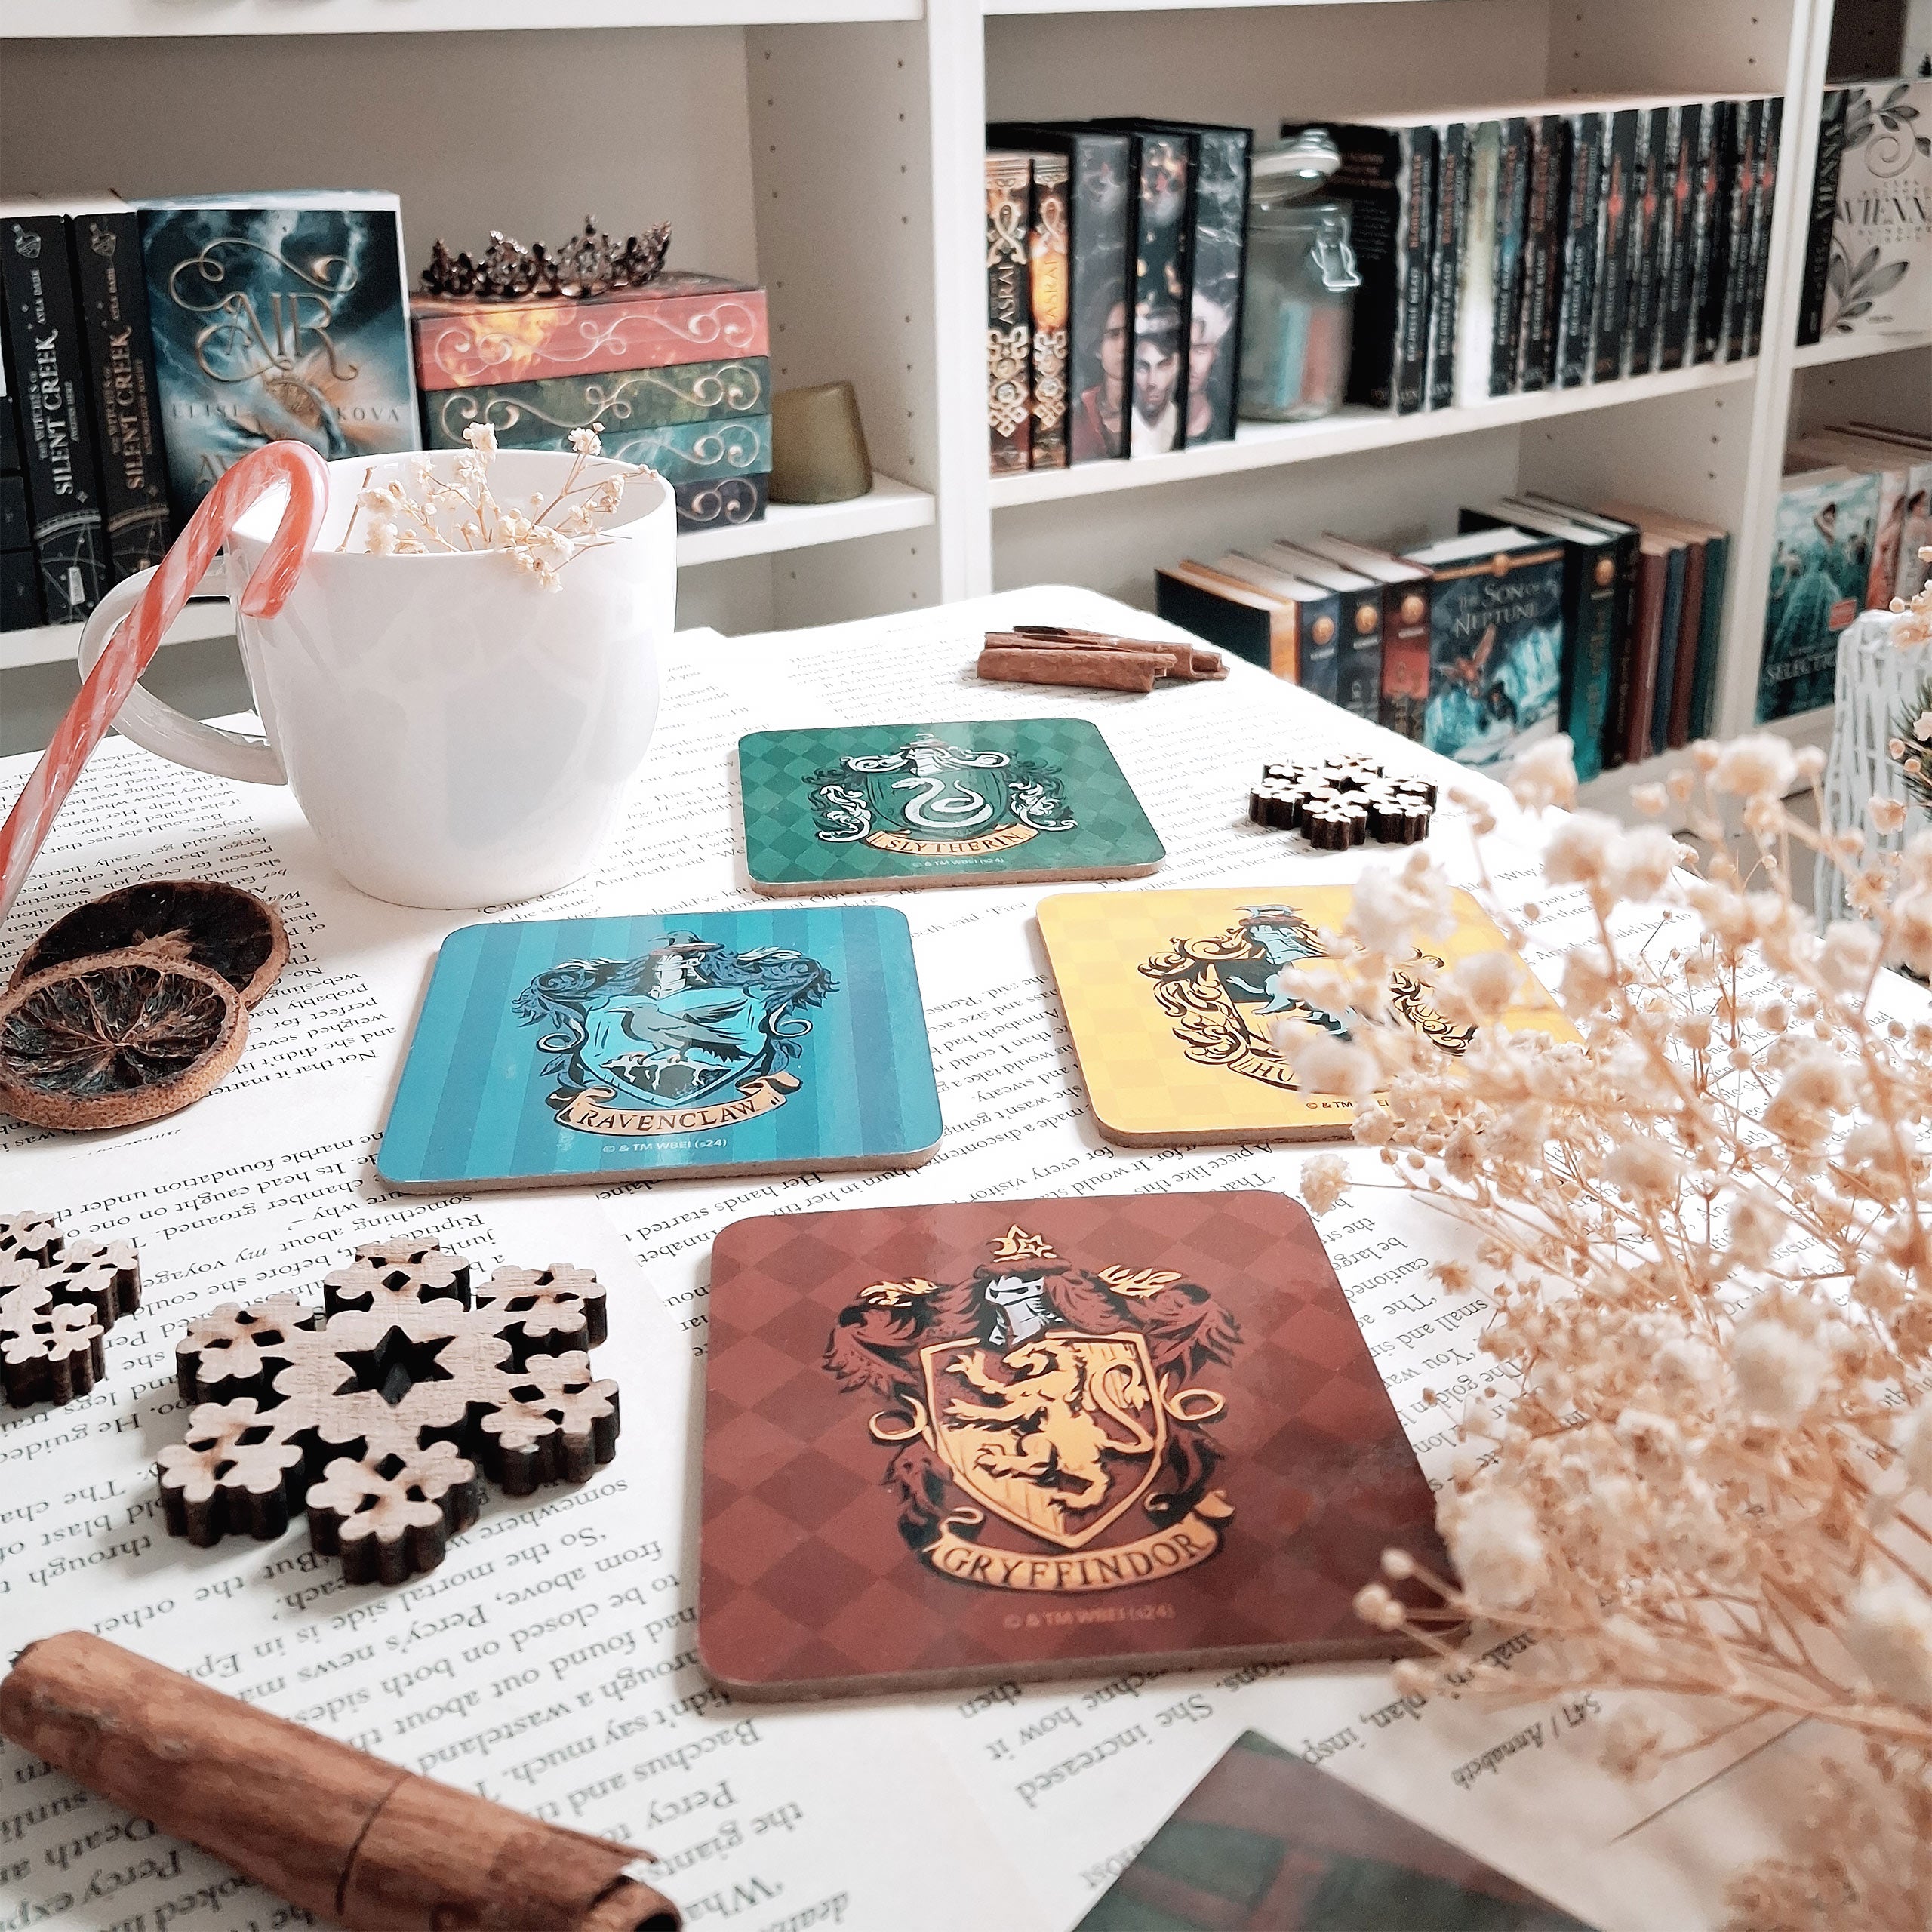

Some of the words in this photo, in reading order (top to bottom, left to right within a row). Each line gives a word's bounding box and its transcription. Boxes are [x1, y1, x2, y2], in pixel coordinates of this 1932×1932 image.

[35, 329, 63, 411] CREEK
[109, 326, 134, 405] CREEK
[46, 417, 74, 495] SILENT
[118, 414, 144, 490] SILENT
[103, 765, 158, 783] broken
[123, 779, 182, 795] stalling
[134, 792, 176, 802] knew
[82, 801, 128, 813] where
[143, 807, 195, 821] stalled
[146, 818, 190, 832] could
[188, 816, 254, 832] projects.
[50, 842, 82, 854] that
[149, 844, 174, 854] get
[181, 835, 226, 849] could
[217, 837, 267, 852] forgot
[219, 845, 273, 863] person
[887, 833, 1023, 854] SLYTHERIN
[95, 853, 141, 866] easily
[113, 863, 154, 875] what
[163, 850, 209, 863] about
[59, 873, 103, 886] other
[139, 868, 181, 880] every
[595, 864, 671, 888] Annabeth
[288, 967, 323, 977] No.
[288, 983, 368, 1009] probably
[981, 983, 1019, 998] said.
[310, 997, 377, 1020] perfect
[957, 1011, 990, 1026] size
[306, 1014, 388, 1039] weighed
[978, 1008, 1059, 1039] Annabeth
[941, 1035, 974, 1053] had
[1011, 1029, 1052, 1048] than
[259, 1047, 317, 1067] didn't
[294, 1059, 334, 1075] that
[338, 1049, 377, 1064] Not
[947, 1048, 995, 1071] could
[1001, 1051, 1055, 1074] would
[963, 1067, 1002, 1086] take
[970, 1078, 1035, 1103] sweaty.
[577, 1099, 762, 1131] RAVENCLAW
[994, 1097, 1051, 1120] wasn't
[1332, 1100, 1354, 1109] TM
[942, 1112, 992, 1139] going
[1035, 1106, 1084, 1129] made
[281, 1140, 354, 1164] marble
[633, 1142, 654, 1152] TM
[910, 1128, 1022, 1176] discontented
[1208, 1146, 1254, 1171] piece
[153, 1159, 275, 1194] foundation
[315, 1162, 346, 1175] Its
[862, 1168, 911, 1188] hum
[1032, 1158, 1080, 1181] every
[1171, 1165, 1211, 1184] like
[257, 1171, 311, 1194] head
[262, 1177, 364, 1211] chamber
[966, 1177, 1027, 1202] visitor
[1071, 1170, 1130, 1195] would
[76, 1190, 147, 1217] under
[175, 1186, 250, 1211] caught
[312, 1201, 358, 1221] why
[714, 1186, 779, 1212] hands
[806, 1191, 840, 1206] her
[89, 1217, 131, 1232] one
[155, 1203, 257, 1241] groaned.
[352, 1194, 472, 1232] something
[636, 1208, 709, 1241] started
[279, 1228, 344, 1251] about
[1377, 1236, 1408, 1254] be
[234, 1247, 268, 1264] my
[256, 1255, 331, 1281] before
[145, 1260, 226, 1287] voyage
[1343, 1257, 1429, 1305] cautioned
[1434, 1300, 1488, 1331] small
[98, 1413, 143, 1434] He
[64, 1480, 125, 1504] The
[481, 1480, 628, 1538] somewhere
[42, 1515, 113, 1546] blast
[29, 1536, 152, 1586] through
[594, 1541, 662, 1572] from
[943, 1532, 1208, 1586] GRYFFINDOR
[401, 1562, 495, 1612] mortal
[495, 1567, 586, 1605] above,
[609, 1587, 647, 1607] be
[333, 1604, 387, 1631] side
[386, 1604, 488, 1650] Percy's
[509, 1603, 599, 1653] closed
[297, 1645, 375, 1681] news
[549, 1631, 635, 1681] found
[380, 1659, 455, 1697] both
[491, 1669, 540, 1697] out
[395, 1690, 480, 1734] about
[1155, 1695, 1213, 1727] She
[418, 1703, 572, 1770] wasteland
[608, 1715, 648, 1742] say
[1020, 1707, 1082, 1745] how
[633, 1715, 762, 1780] Bacchus
[502, 1736, 597, 1785] much.
[1014, 1724, 1148, 1809] increased
[648, 1780, 737, 1829] Percy
[44, 1817, 158, 1872] Death
[82, 1850, 182, 1906] Percy
